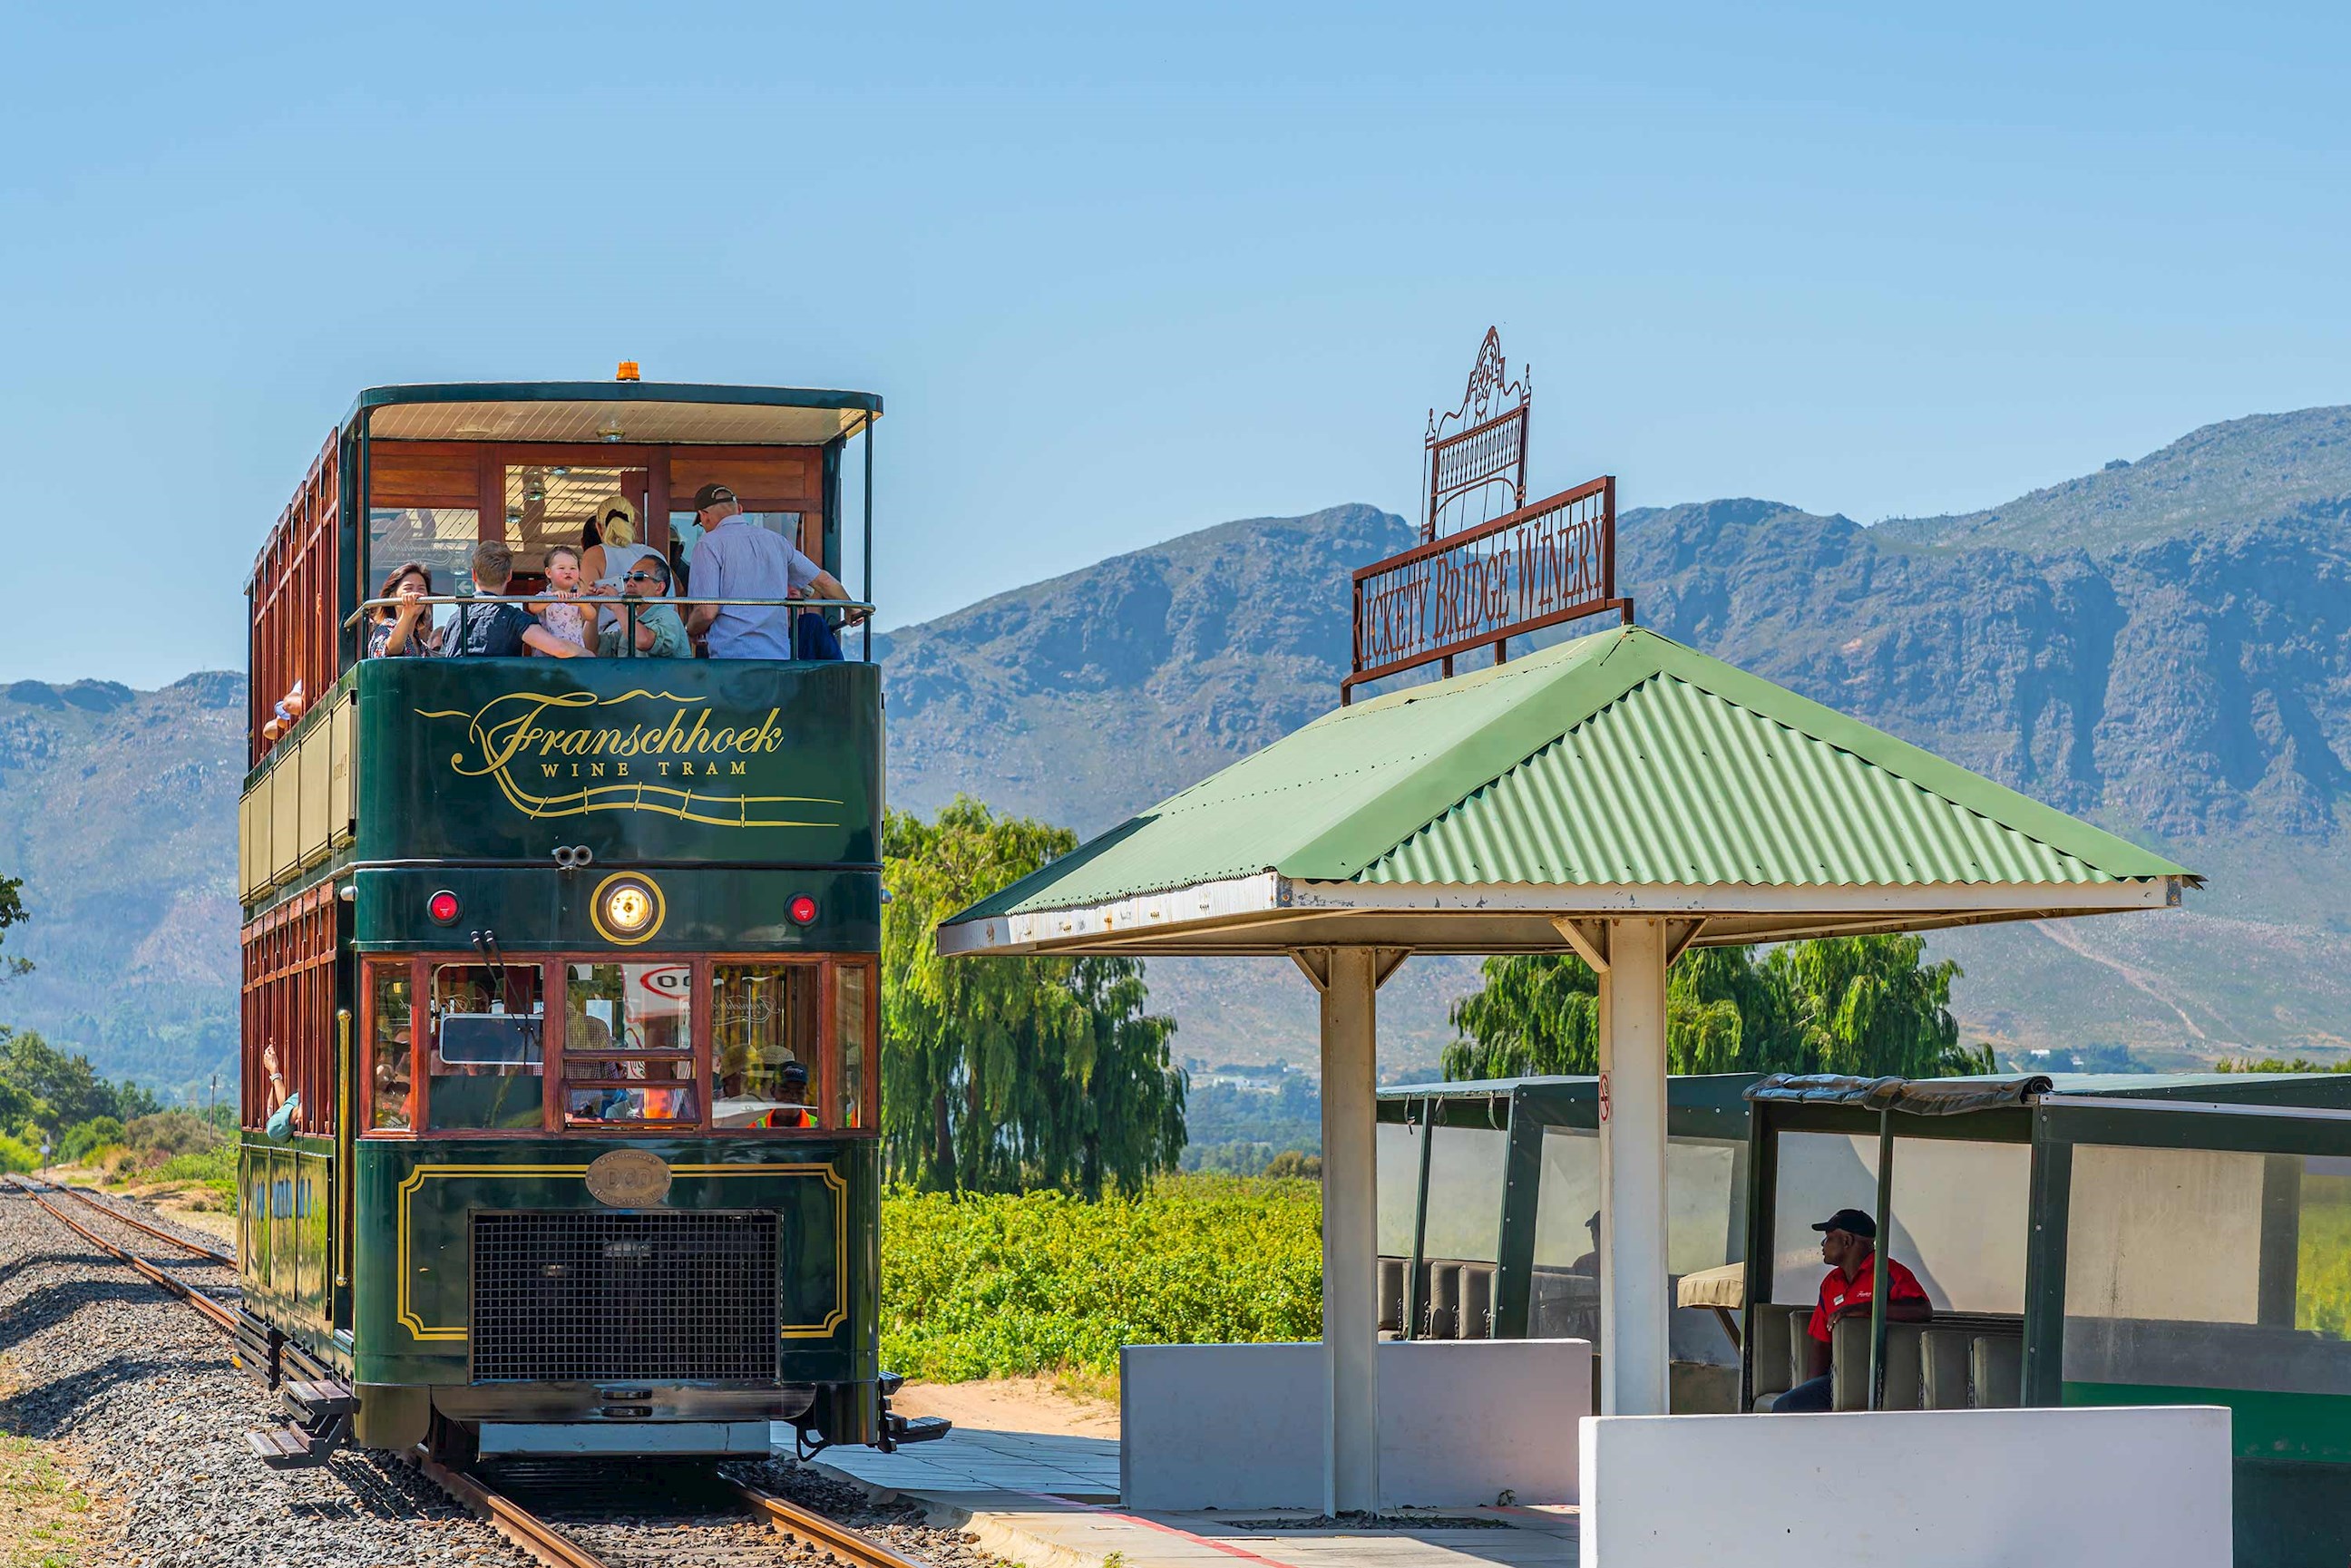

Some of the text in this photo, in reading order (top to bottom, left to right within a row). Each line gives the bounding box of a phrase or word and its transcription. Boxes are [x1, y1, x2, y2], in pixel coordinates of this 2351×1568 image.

[1351, 512, 1606, 665] RICKETY BRIDGE WINERY
[451, 690, 784, 777] Franschhoek
[541, 760, 746, 778] WINE TRAM
